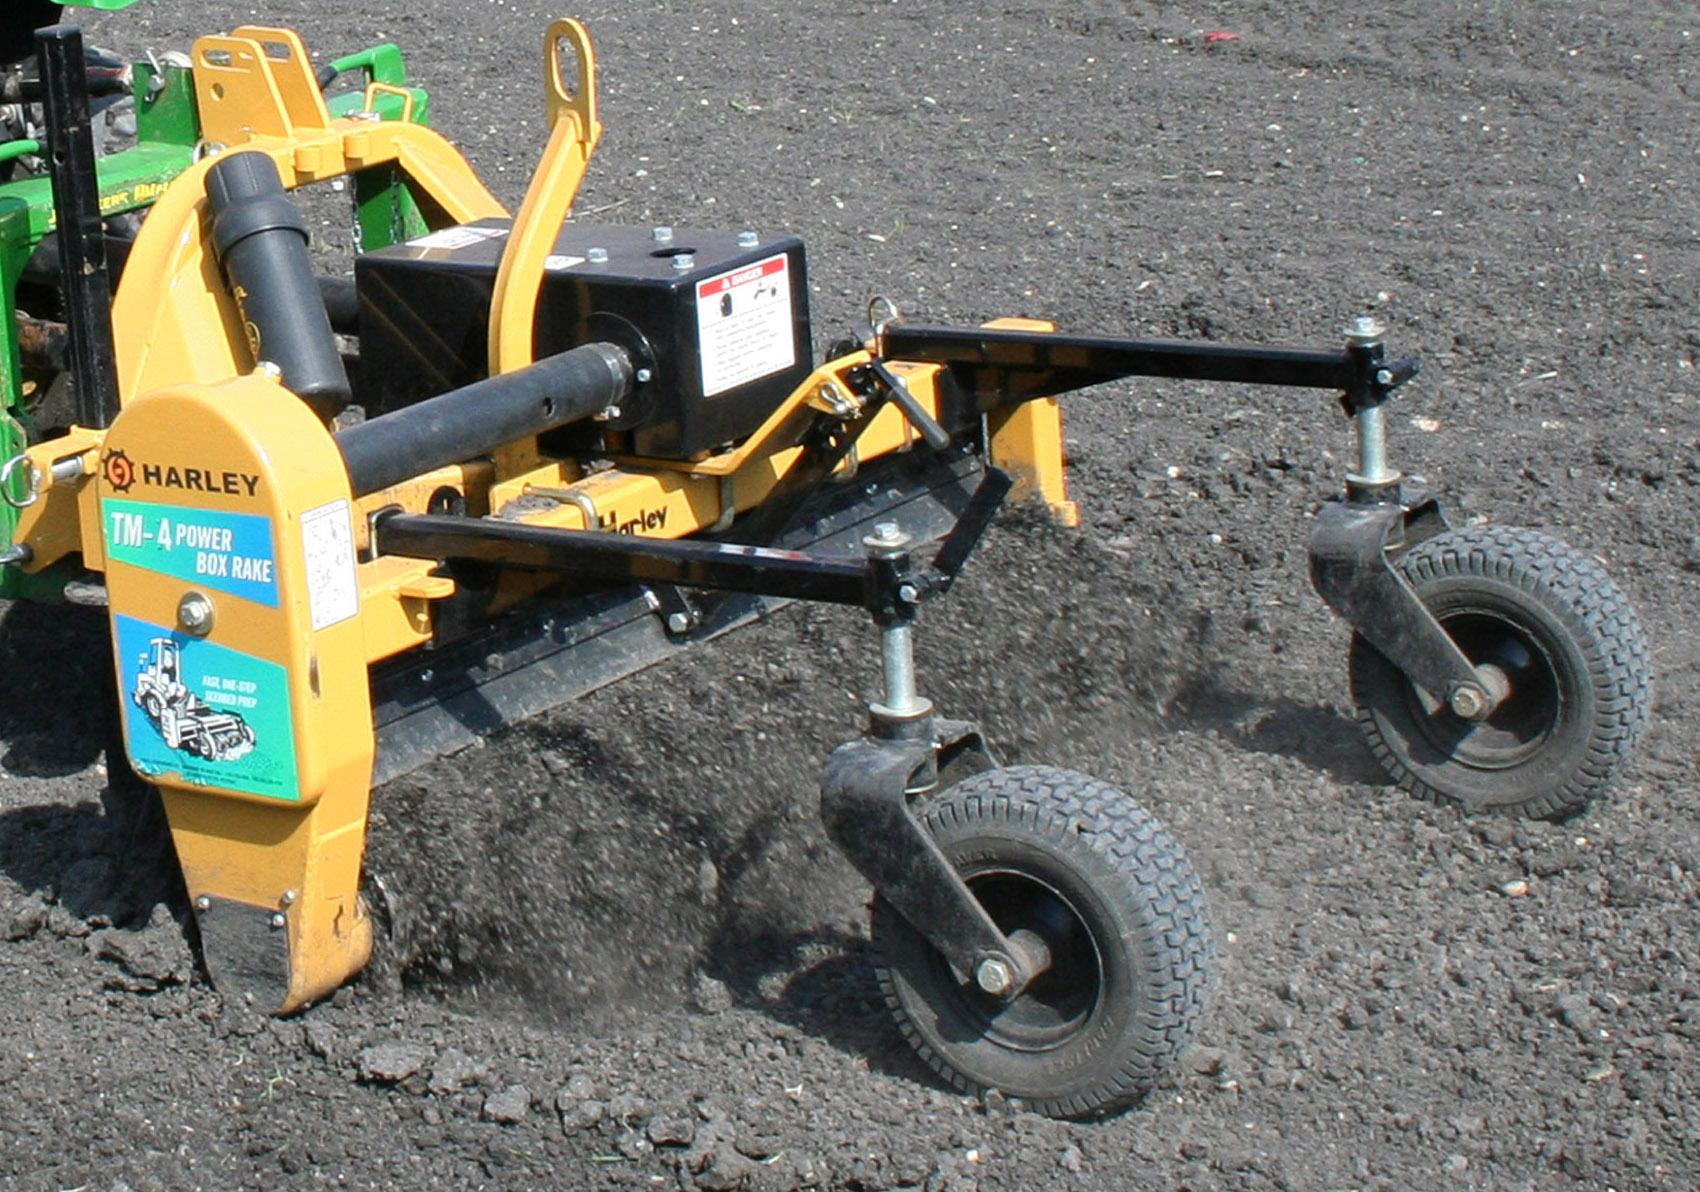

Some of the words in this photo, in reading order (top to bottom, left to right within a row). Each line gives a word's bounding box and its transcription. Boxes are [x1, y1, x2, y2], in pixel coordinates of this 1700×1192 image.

[143, 464, 259, 496] HARLEY
[111, 512, 172, 551] TM-4
[176, 523, 233, 551] POWER
[196, 552, 228, 577] BOX
[232, 556, 272, 583] RAKE
